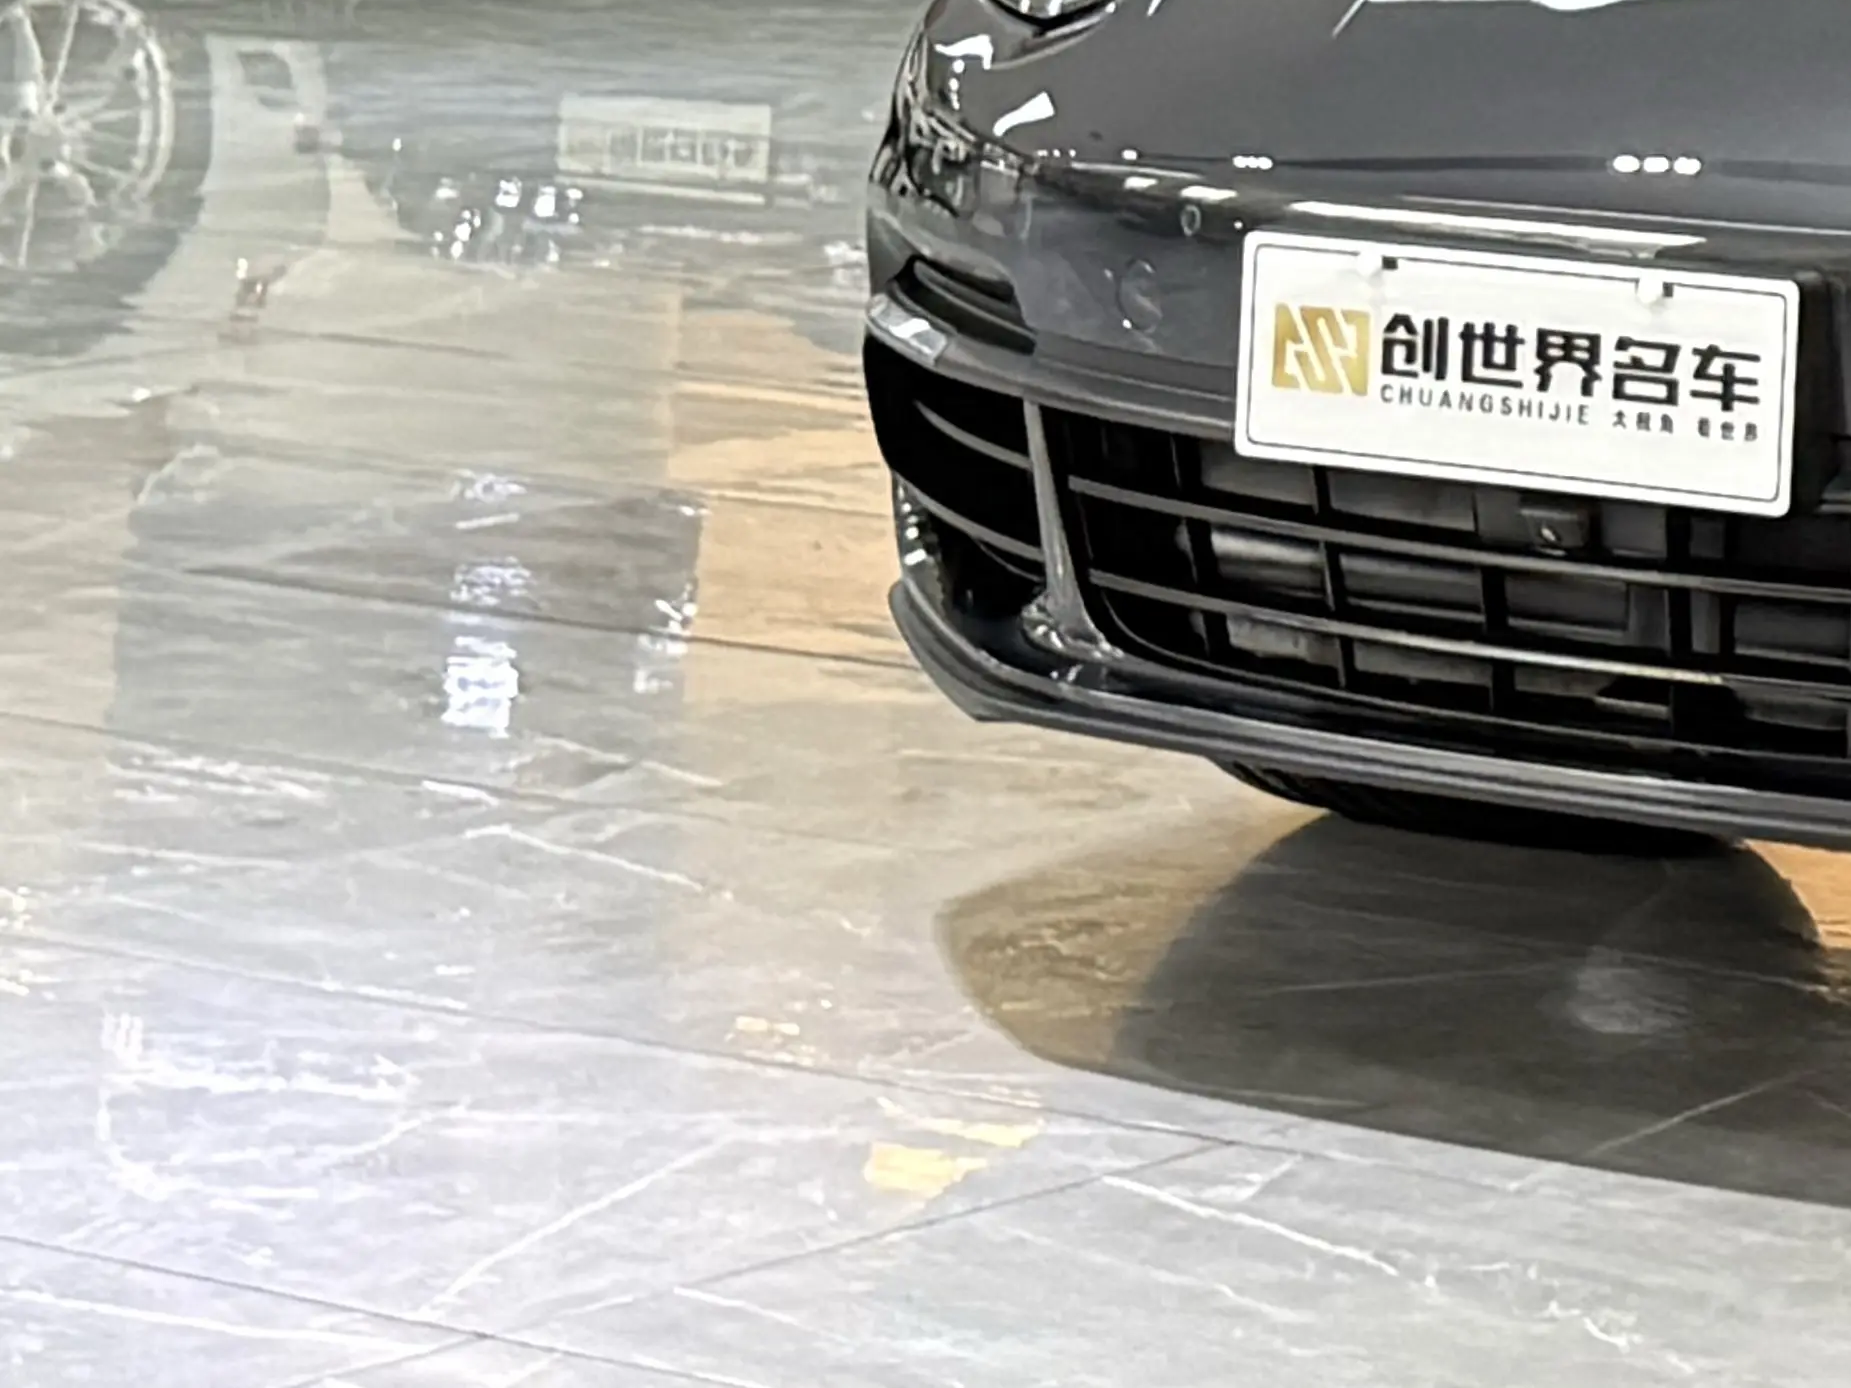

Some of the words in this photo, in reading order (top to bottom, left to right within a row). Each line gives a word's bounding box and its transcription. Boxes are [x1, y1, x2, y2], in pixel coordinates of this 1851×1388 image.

[1381, 313, 1762, 411] 创世界名车
[1380, 383, 1590, 426] CHUANGSHIJIE
